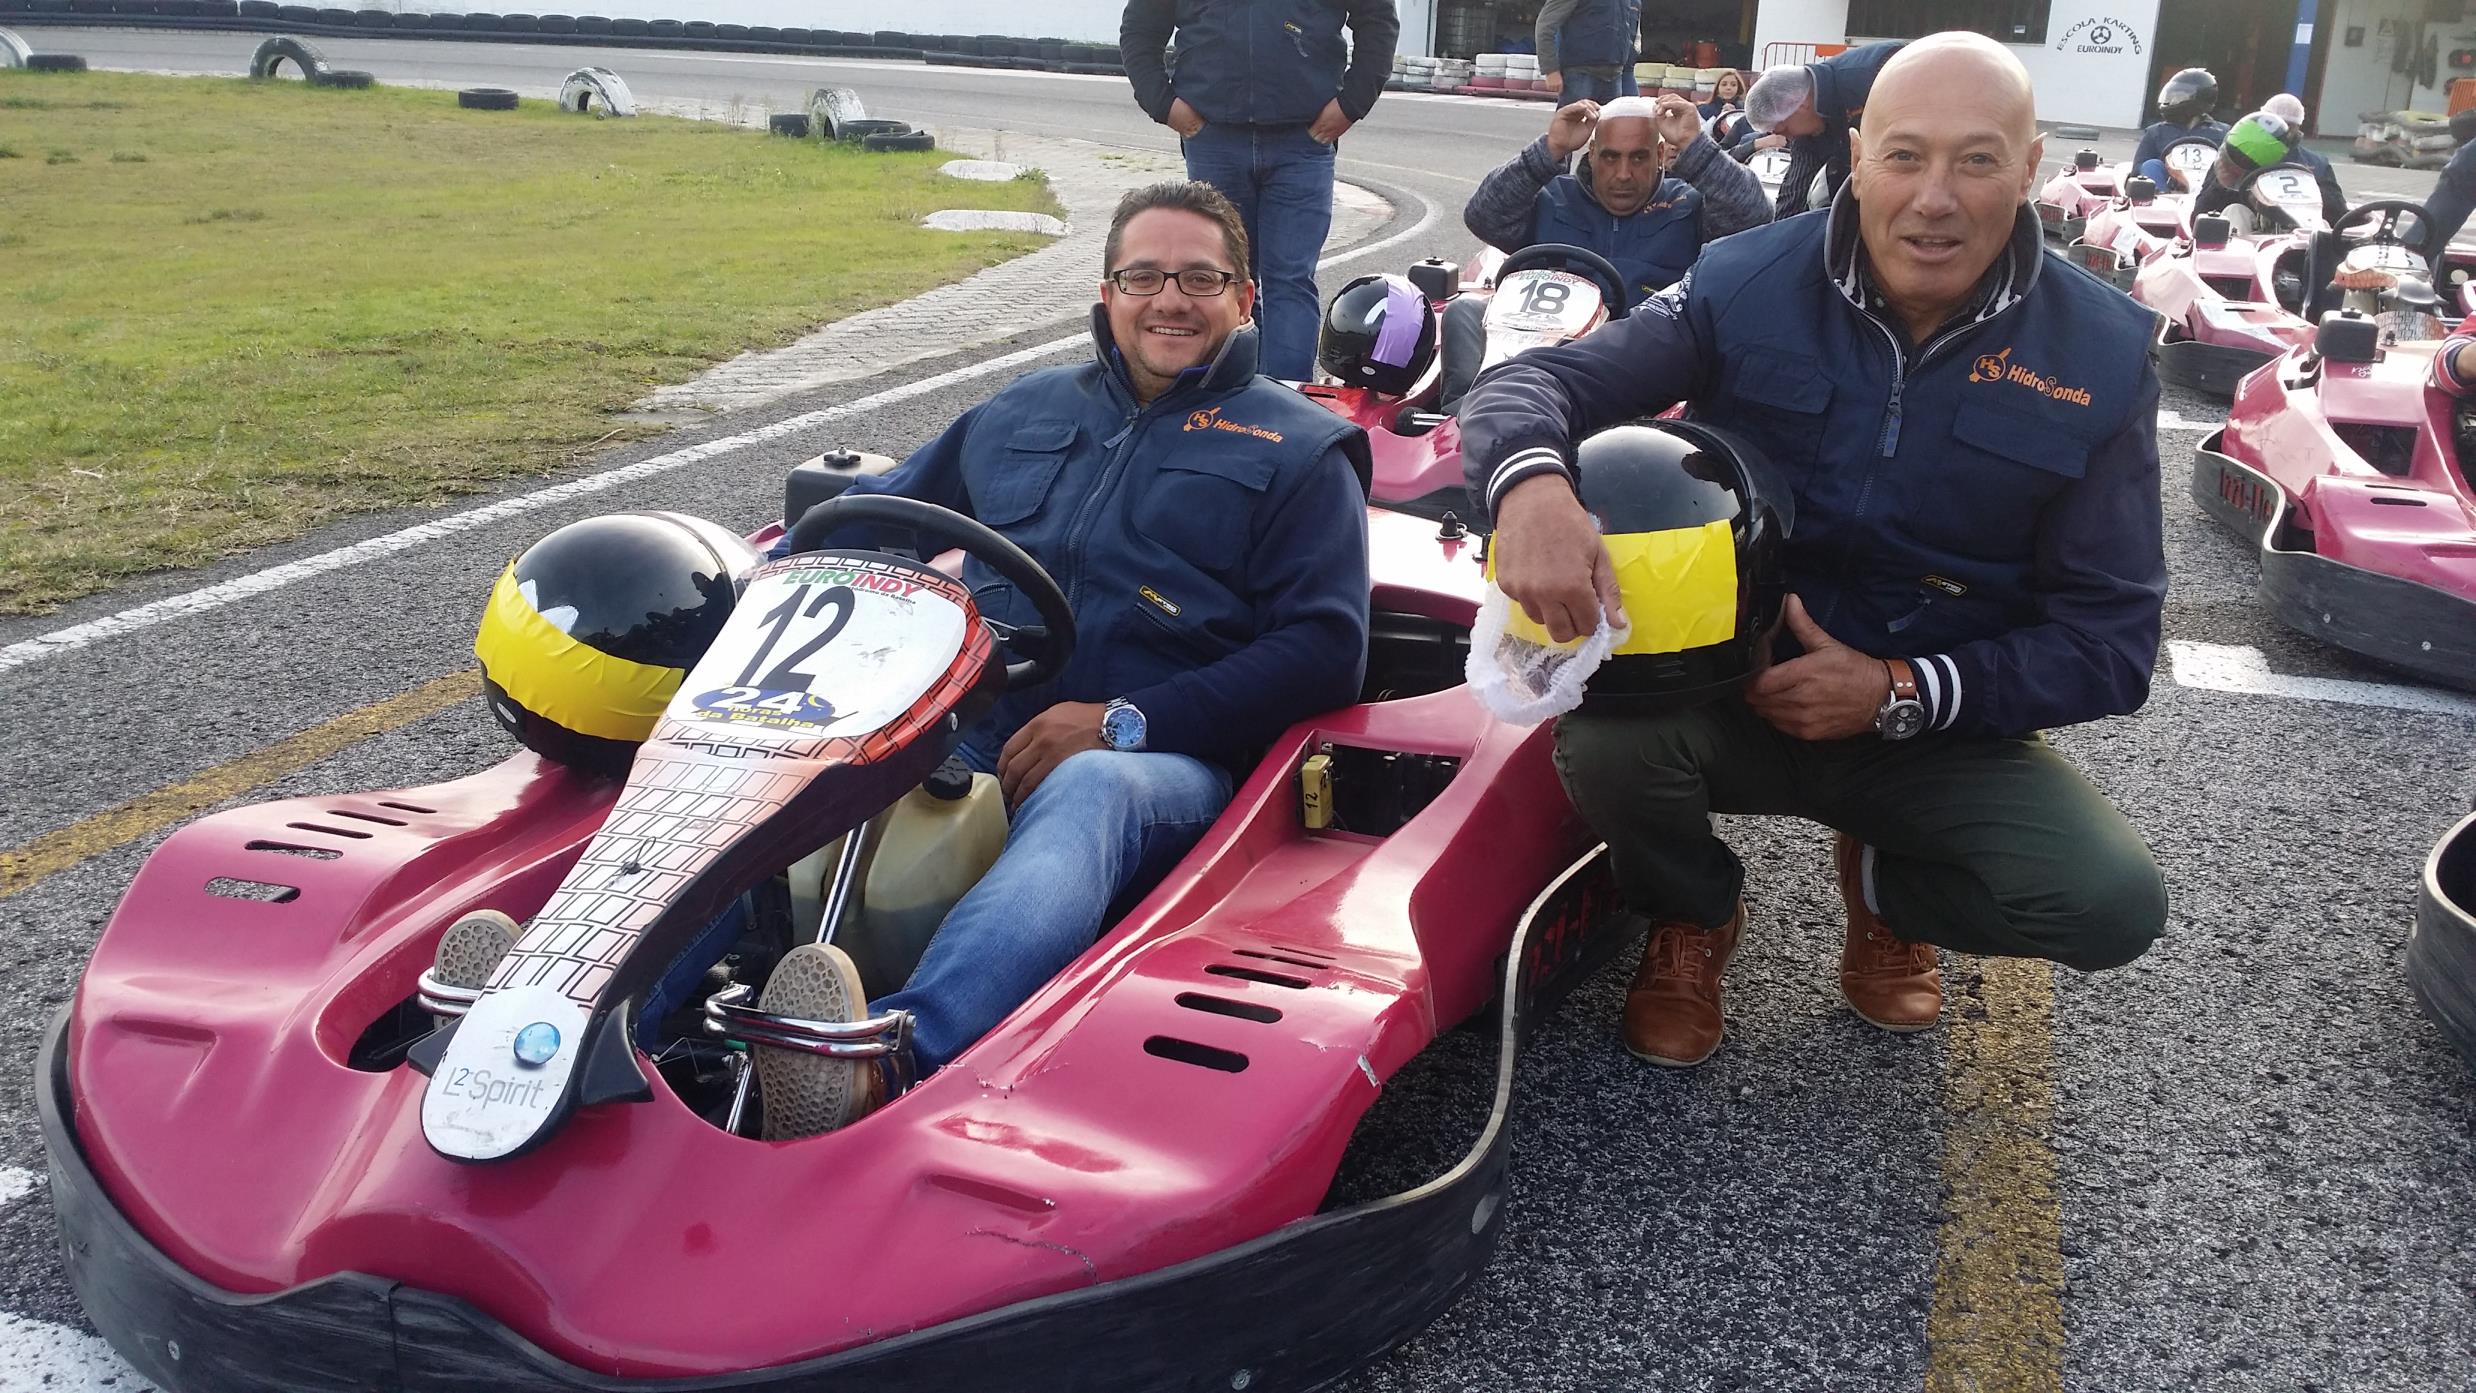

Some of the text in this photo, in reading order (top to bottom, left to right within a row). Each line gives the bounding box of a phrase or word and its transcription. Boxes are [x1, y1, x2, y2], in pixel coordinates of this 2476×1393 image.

[2057, 17, 2142, 55] ESCOLA KARTING
[2077, 44, 2123, 54] EUROINDY
[2181, 148, 2202, 162] 13
[2279, 176, 2303, 194] 2
[1519, 280, 1571, 315] 18
[2007, 364, 2091, 406] HidroSonda
[1213, 419, 1283, 443] HidroSonda
[783, 570, 921, 598] EUROINDY
[732, 583, 856, 691] 12
[708, 686, 805, 715] 24
[727, 704, 783, 716] horas
[696, 710, 815, 729] da Batalha
